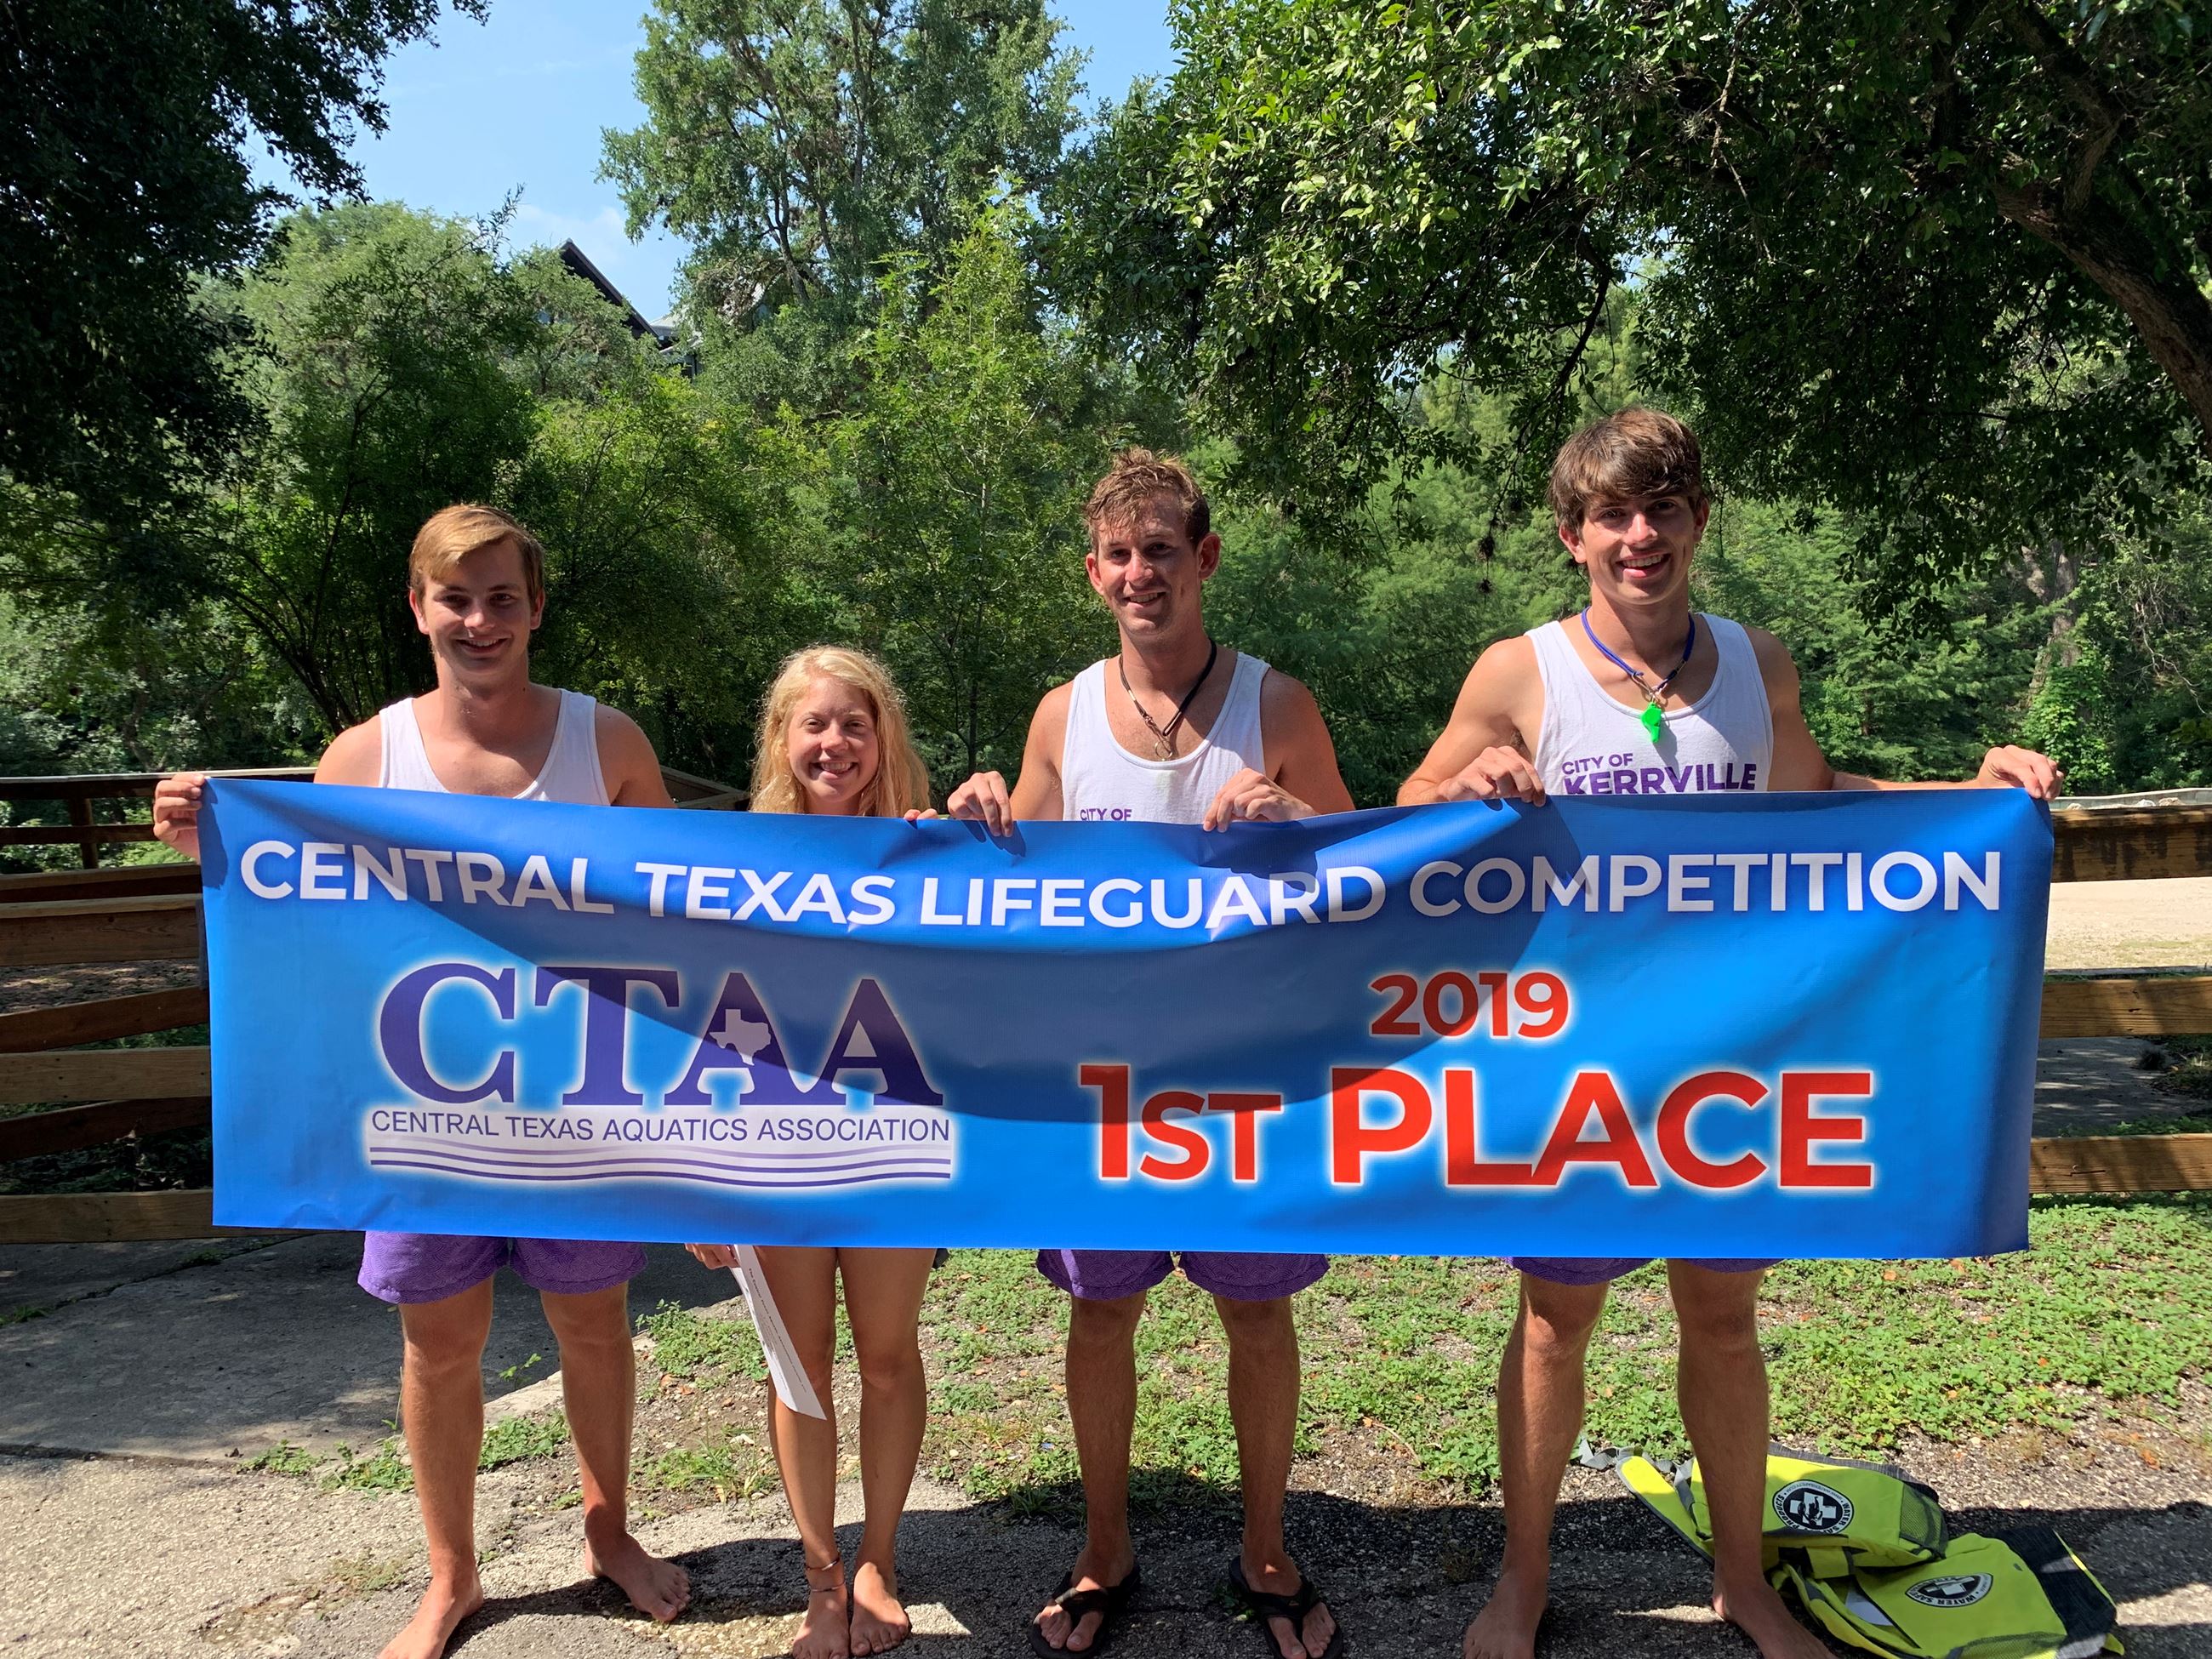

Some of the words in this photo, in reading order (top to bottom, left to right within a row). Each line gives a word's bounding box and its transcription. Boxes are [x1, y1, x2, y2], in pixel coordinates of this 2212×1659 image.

[1561, 755, 1604, 775] CITY
[1608, 753, 1633, 767] OF
[1564, 762, 1757, 795] KERRVILLE
[1080, 808, 1108, 821] CITY
[1110, 808, 1132, 821] OF
[241, 840, 615, 915] CENTRAL
[635, 861, 896, 926] TEXAS
[920, 864, 1387, 930] LIFEGUARD
[1409, 851, 2001, 917] COMPETITION
[1369, 972, 1570, 1039] 2019
[379, 962, 944, 1106] CTAA
[371, 1109, 499, 1137] CENTRAL
[505, 1115, 594, 1141] TEXAS
[601, 1118, 749, 1143] AQUATICS
[756, 1118, 950, 1142] ASSOCIATION
[1080, 1063, 1283, 1181] 1ST
[1331, 1067, 1873, 1189] PLACE
[1839, 1502, 1852, 1526] WATER
[1937, 1594, 1976, 1606] WATER
